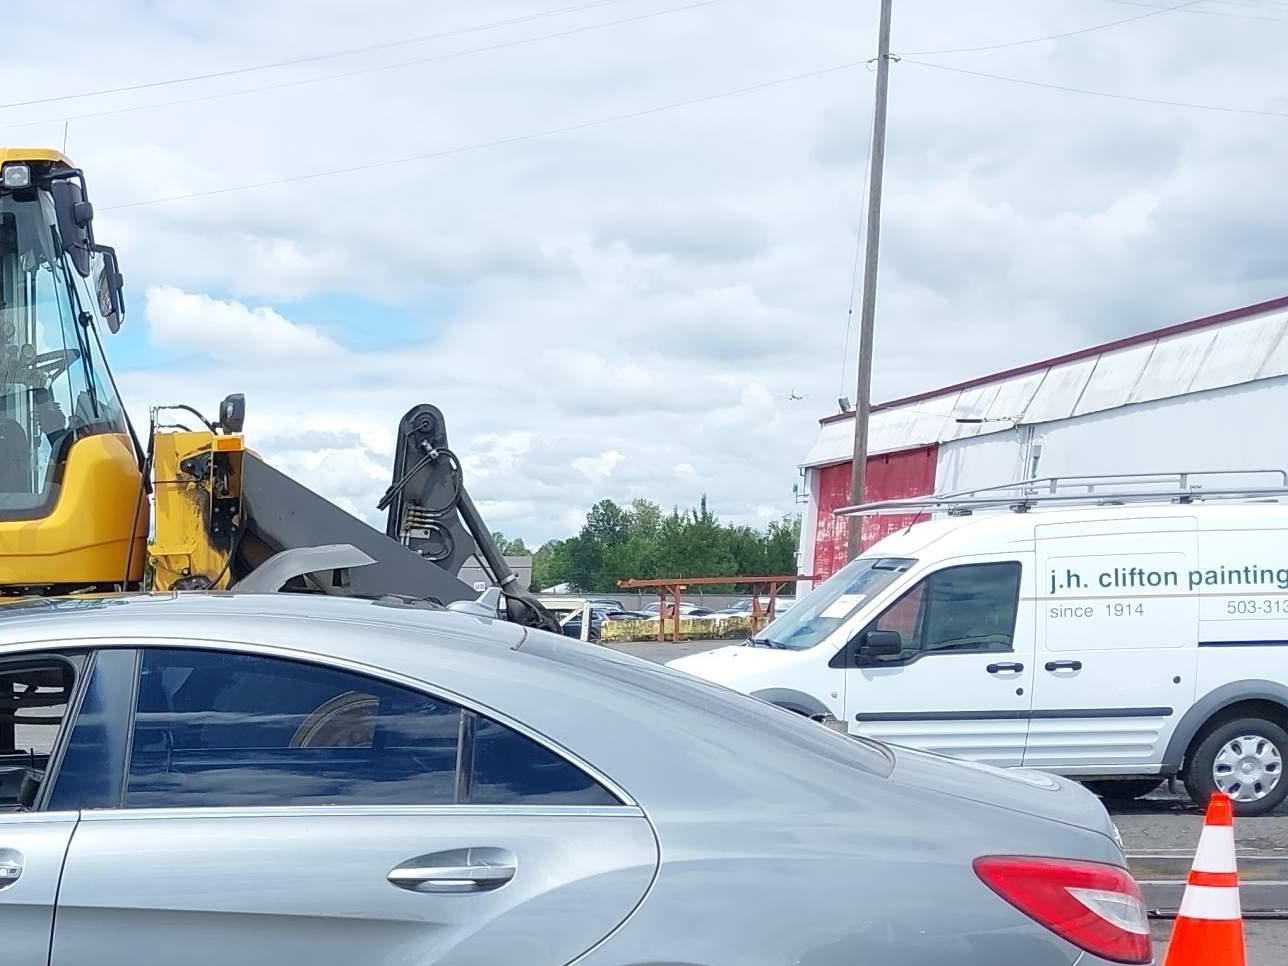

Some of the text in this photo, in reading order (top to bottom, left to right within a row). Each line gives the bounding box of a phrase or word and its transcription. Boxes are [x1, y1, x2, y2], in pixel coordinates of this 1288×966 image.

[1050, 565, 1288, 594] j.h. clifton painting
[1050, 603, 1144, 618] since 1914
